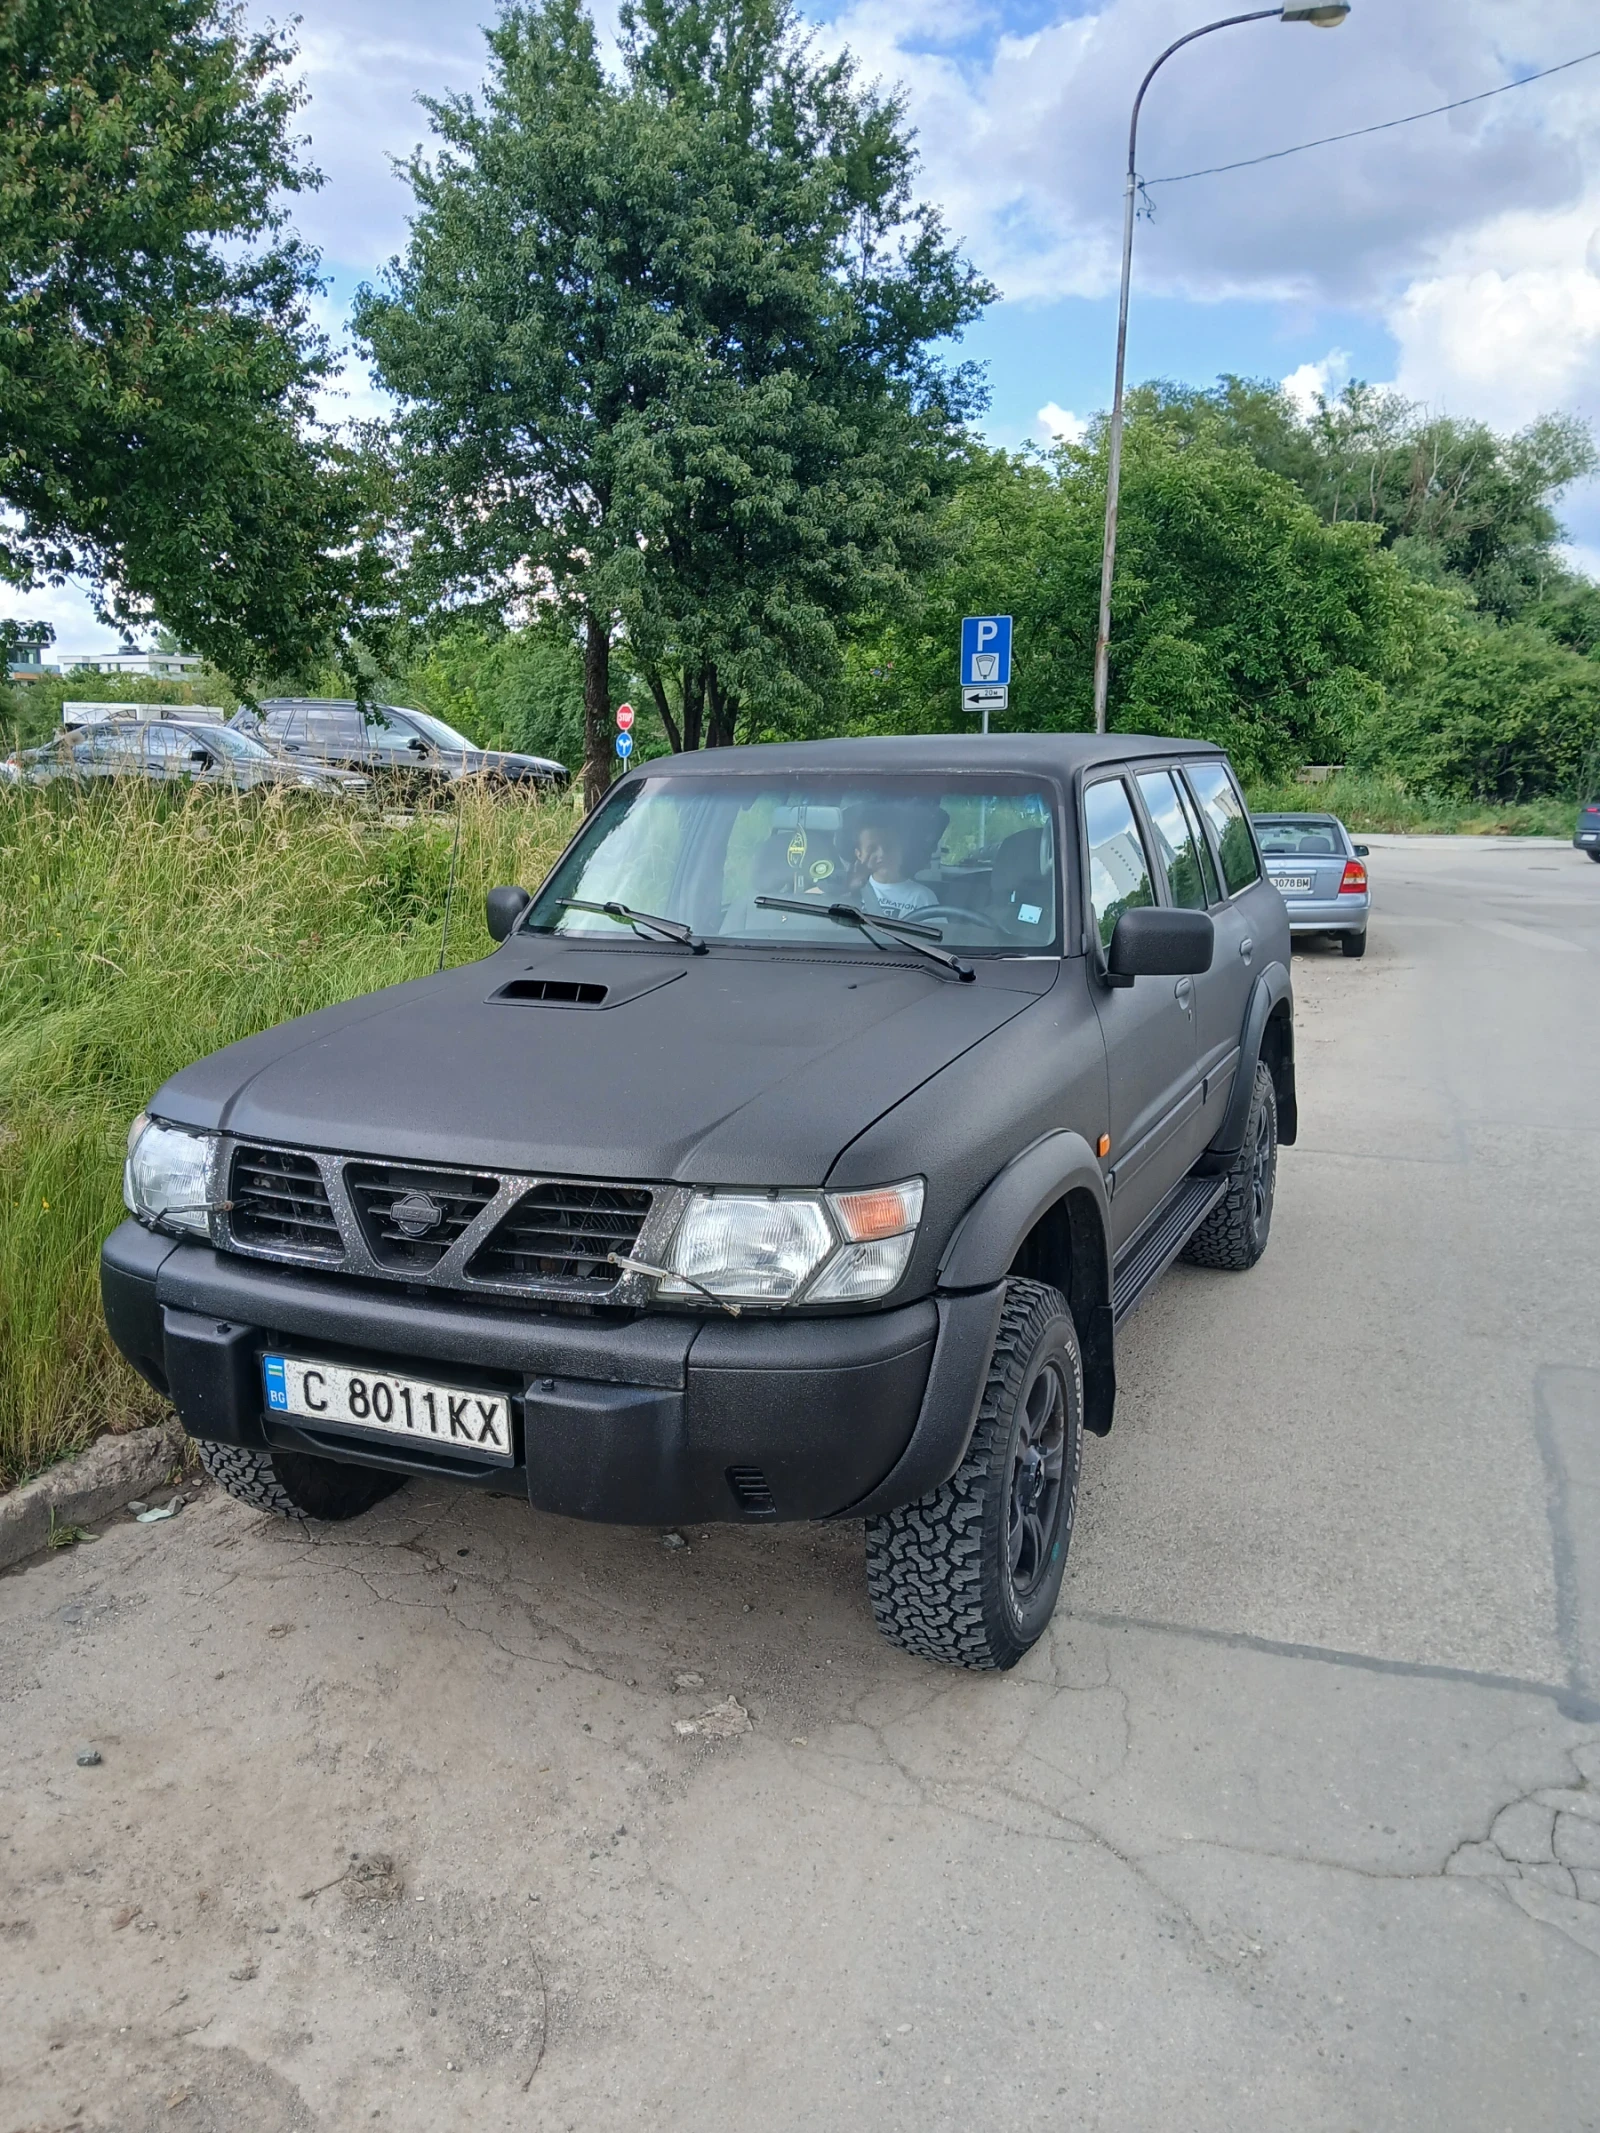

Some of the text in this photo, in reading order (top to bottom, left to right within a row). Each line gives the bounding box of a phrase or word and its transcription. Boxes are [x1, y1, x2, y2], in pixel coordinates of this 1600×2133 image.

[977, 621, 998, 652] P
[618, 712, 632, 722] STOP
[270, 1390, 286, 1404] BG
[303, 1370, 327, 1412] C
[1063, 1340, 1082, 1530] All-Terrain T/A
